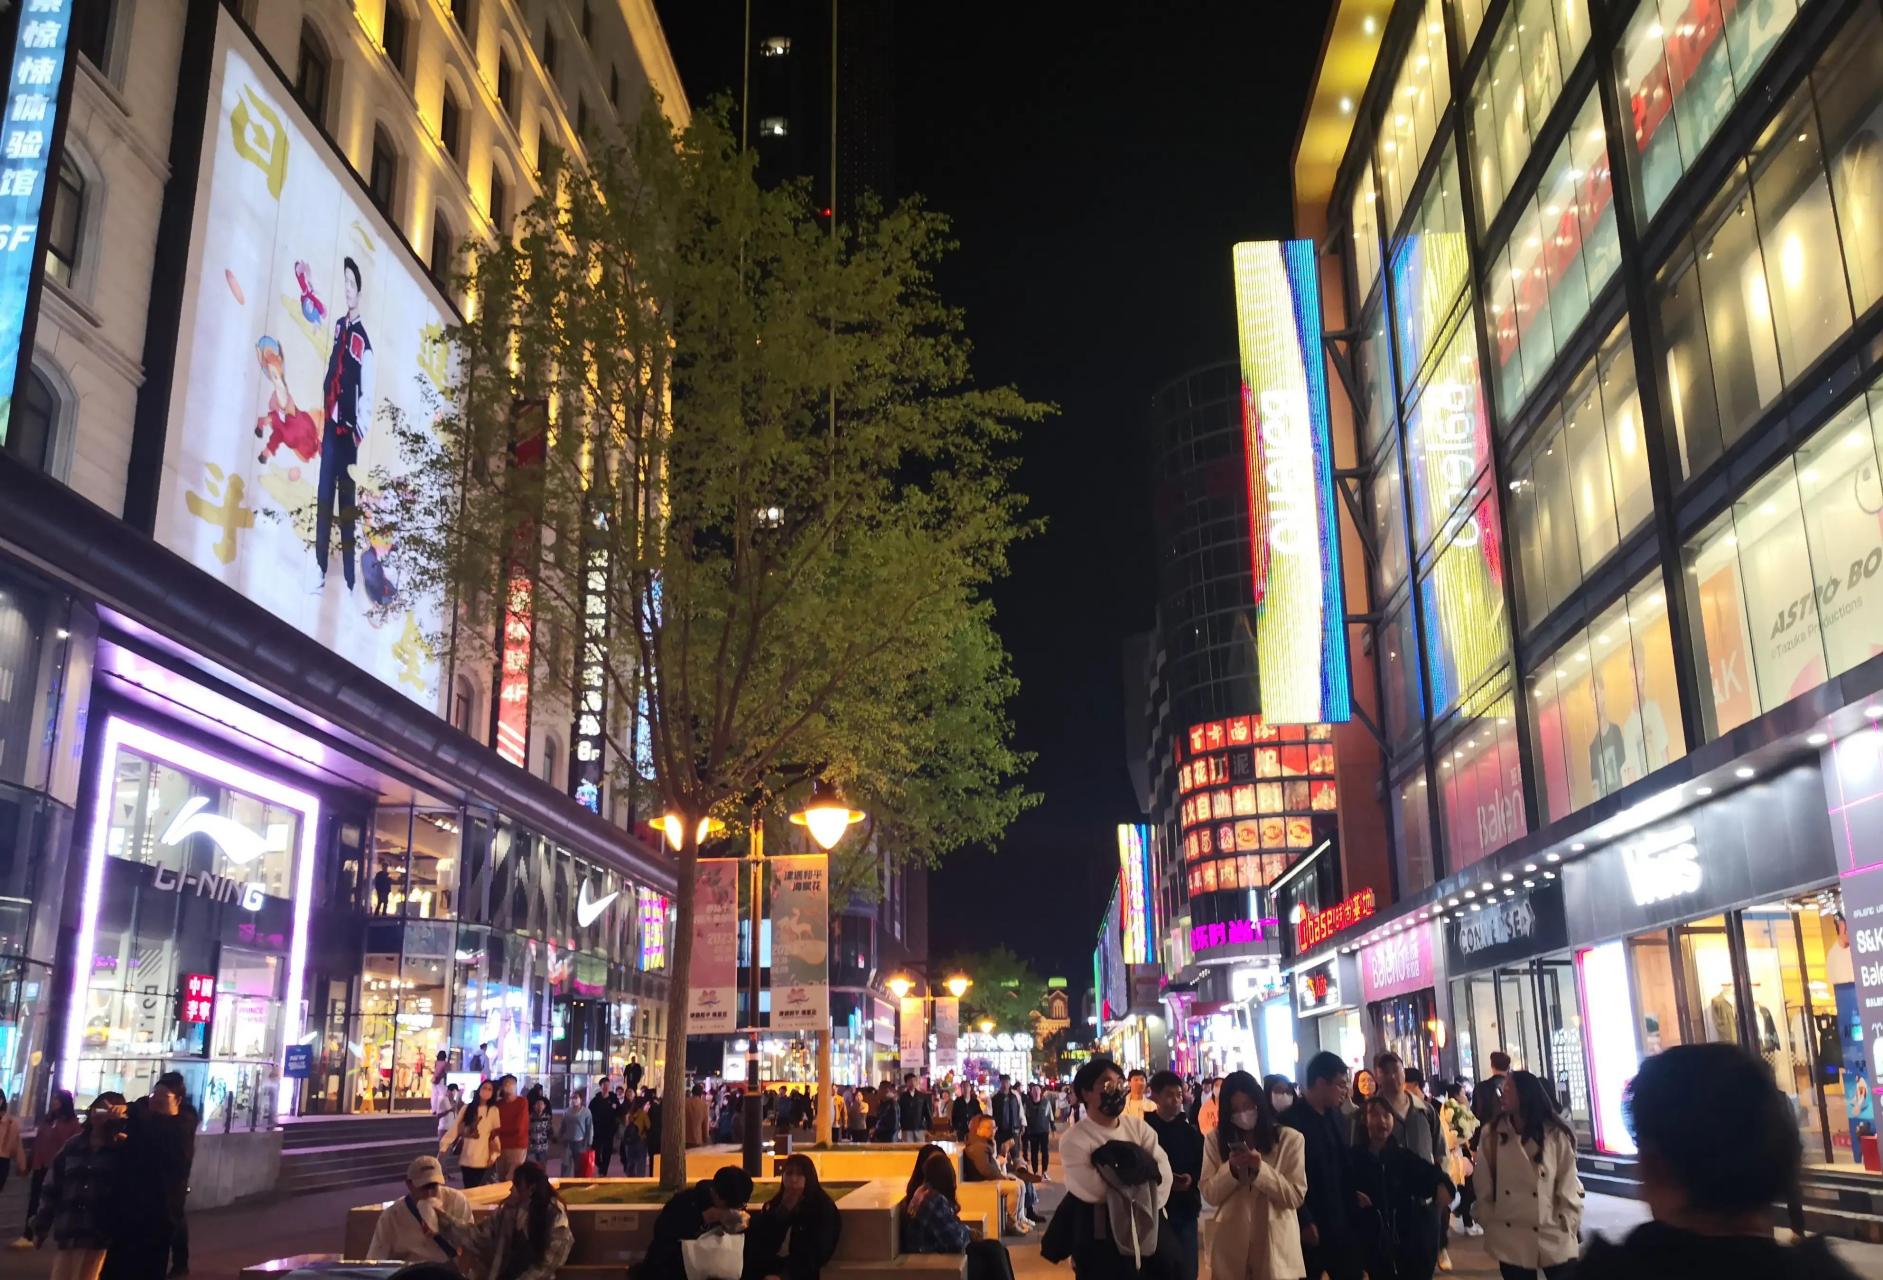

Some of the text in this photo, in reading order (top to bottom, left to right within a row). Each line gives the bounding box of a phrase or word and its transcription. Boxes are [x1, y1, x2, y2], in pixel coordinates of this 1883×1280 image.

[1770, 576, 1841, 640] ASTRO
[502, 685, 528, 702] 4F
[577, 741, 600, 761] 8F
[154, 861, 266, 911] LI-NING
[1621, 824, 1702, 906] VS
